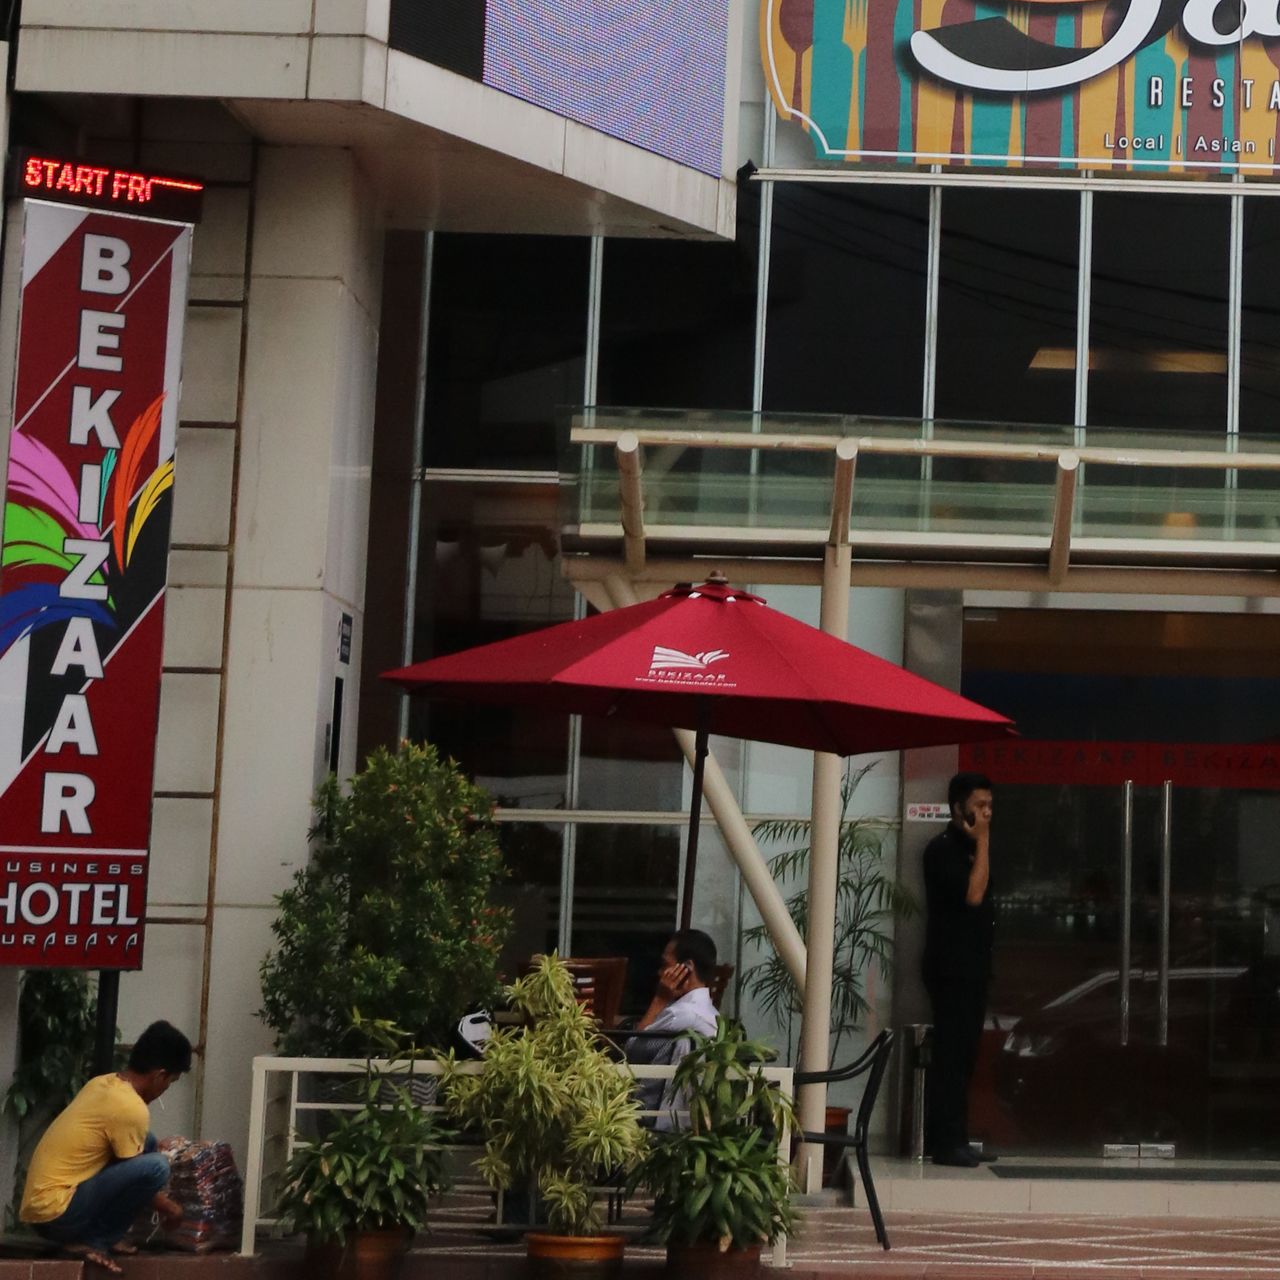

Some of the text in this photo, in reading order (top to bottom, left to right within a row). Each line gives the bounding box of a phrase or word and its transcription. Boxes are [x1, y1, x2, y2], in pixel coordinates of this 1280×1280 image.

[1104, 132, 1164, 151] Local
[1194, 135, 1257, 154] Asian
[25, 157, 153, 203] START FR
[40, 232, 131, 835] BEKIZAAR
[5, 861, 143, 876] USINESS
[0, 932, 139, 953] URABAYA
